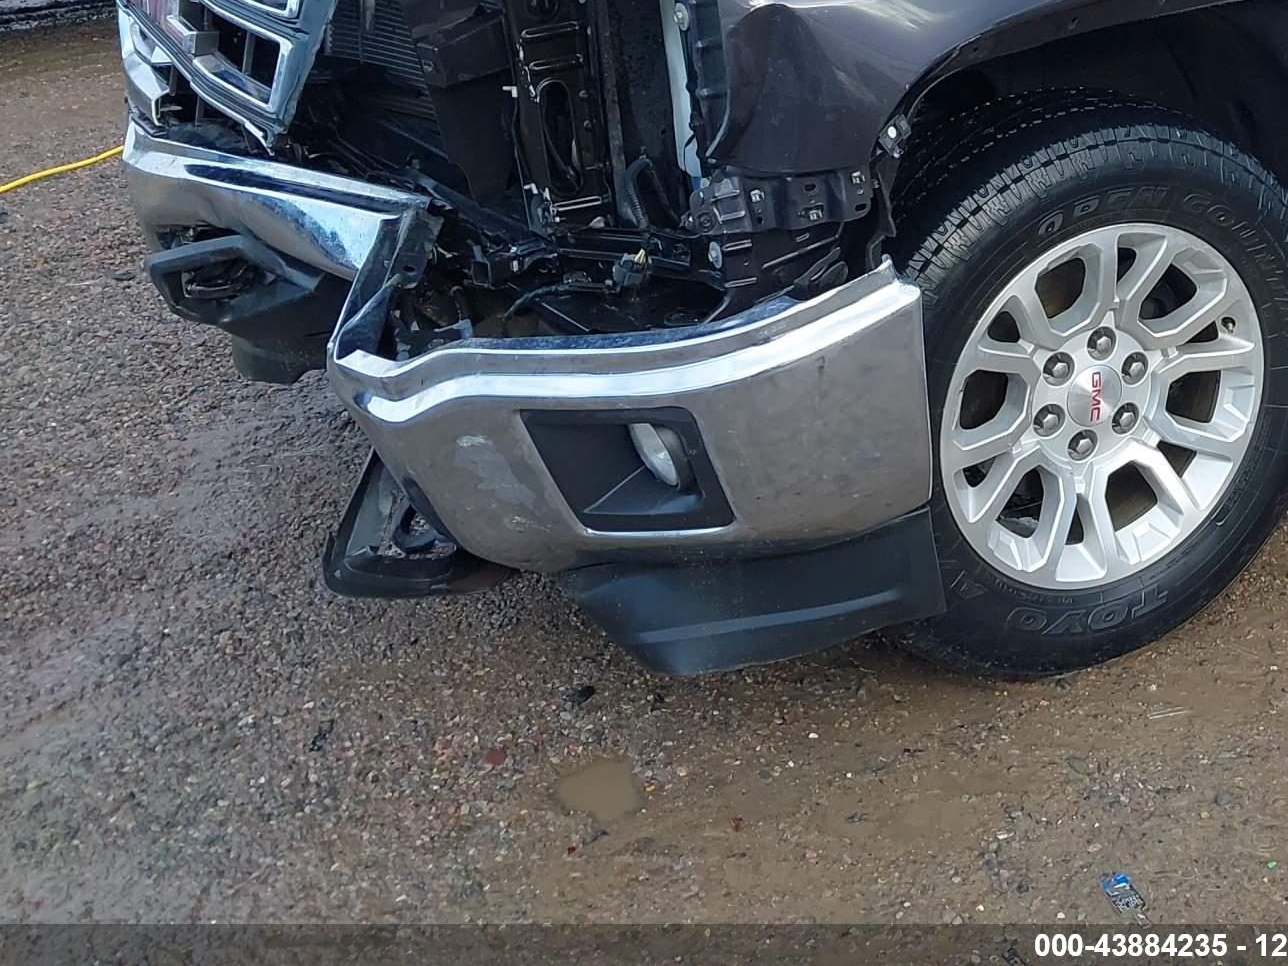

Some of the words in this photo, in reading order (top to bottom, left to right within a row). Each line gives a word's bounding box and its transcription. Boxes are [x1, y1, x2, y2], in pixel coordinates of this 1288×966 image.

[1038, 186, 1170, 236] OPEN
[1090, 371, 1102, 422] GMC
[1006, 584, 1169, 634] TOYO
